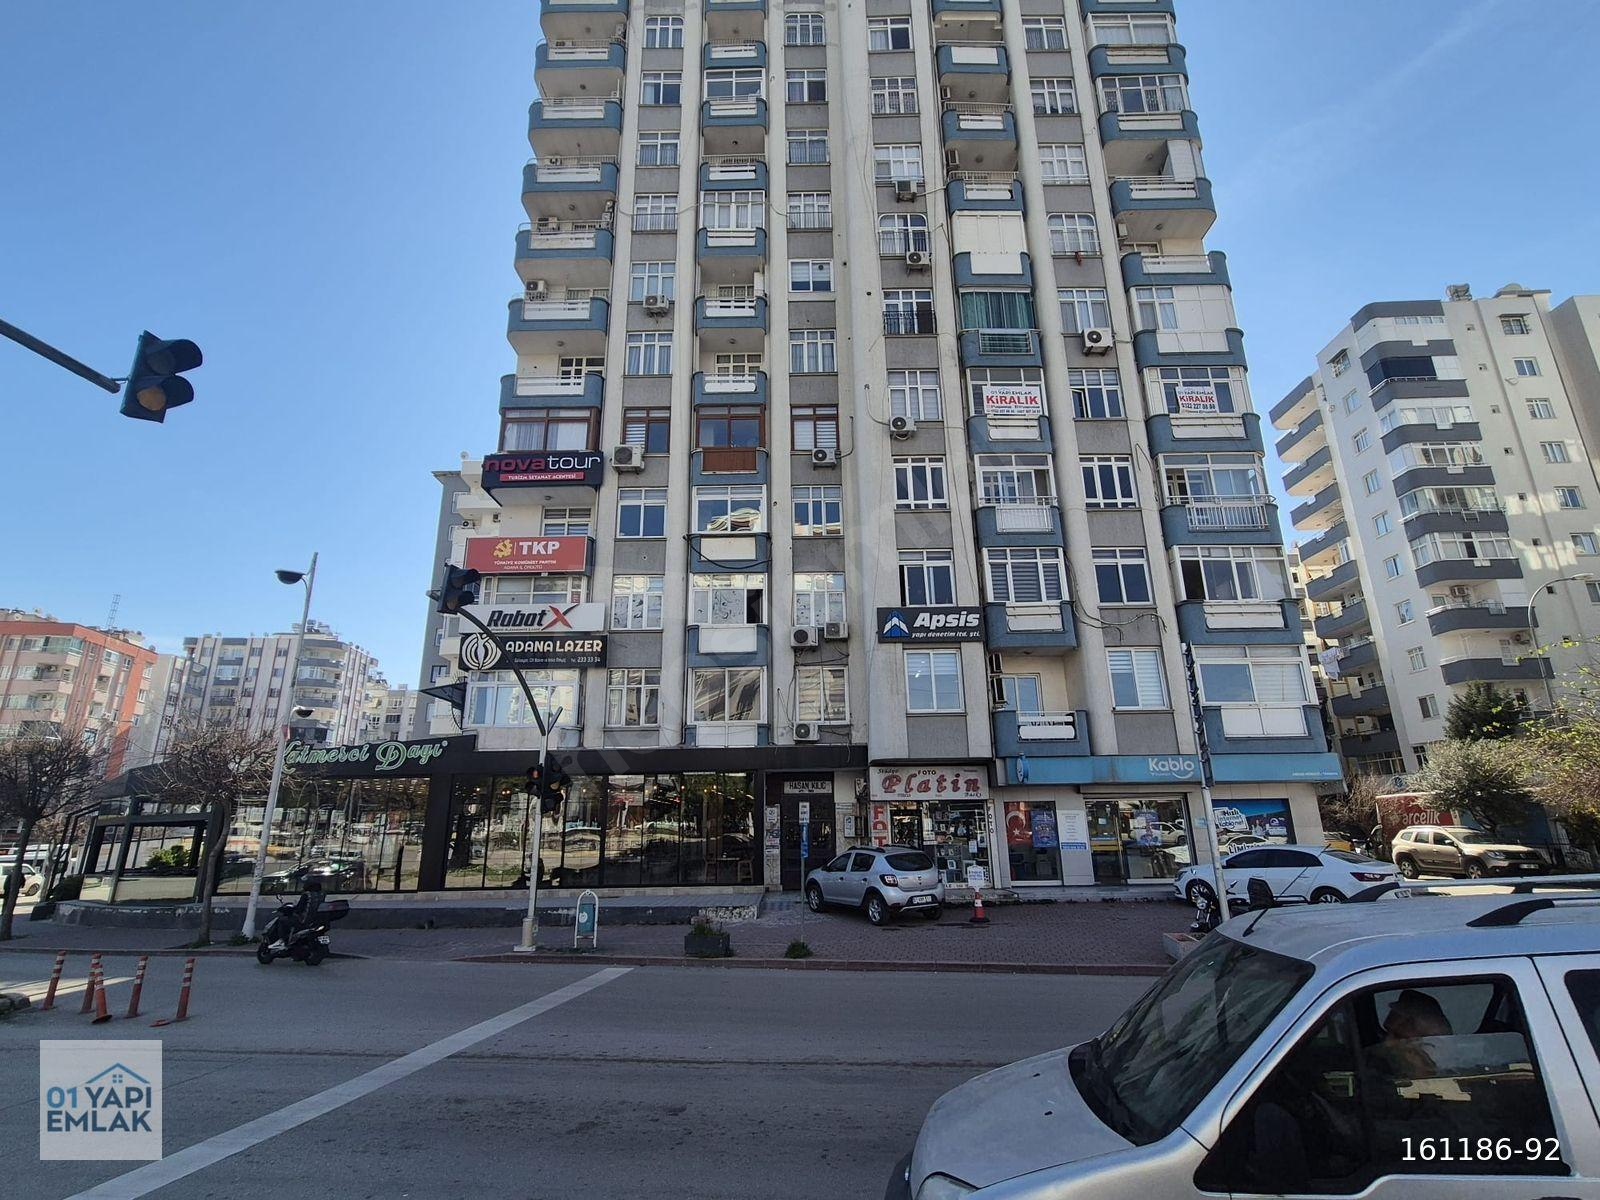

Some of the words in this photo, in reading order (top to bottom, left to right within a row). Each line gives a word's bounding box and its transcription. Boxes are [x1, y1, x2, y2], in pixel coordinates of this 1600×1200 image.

[520, 541, 560, 555] TKP
[913, 611, 980, 630] Apsis
[505, 640, 554, 653] ADANA
[555, 640, 603, 652] LAZER
[1148, 757, 1195, 771] Kablo
[881, 773, 981, 794] Platin
